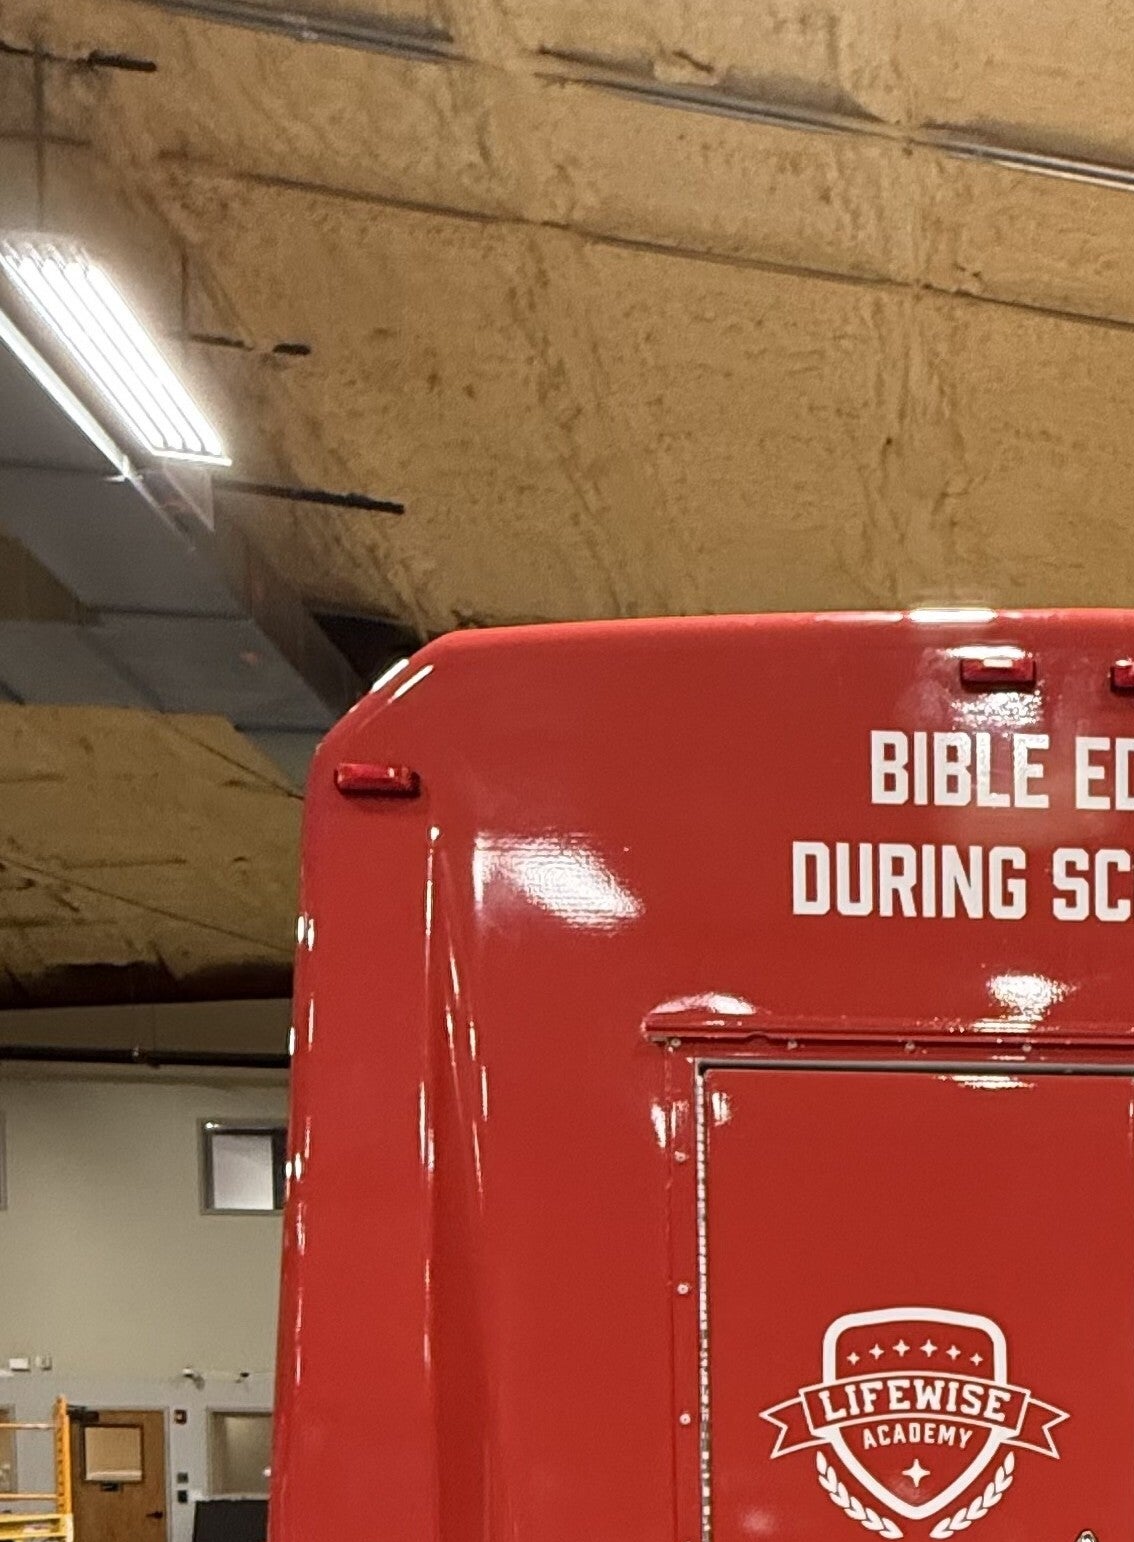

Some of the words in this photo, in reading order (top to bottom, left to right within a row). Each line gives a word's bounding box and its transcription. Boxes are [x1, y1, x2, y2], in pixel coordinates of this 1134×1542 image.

[870, 730, 1049, 809] BIBLE
[792, 841, 1027, 919] DURING
[818, 1379, 1011, 1422] LIFEWISE
[862, 1423, 973, 1450] ACADEMY
